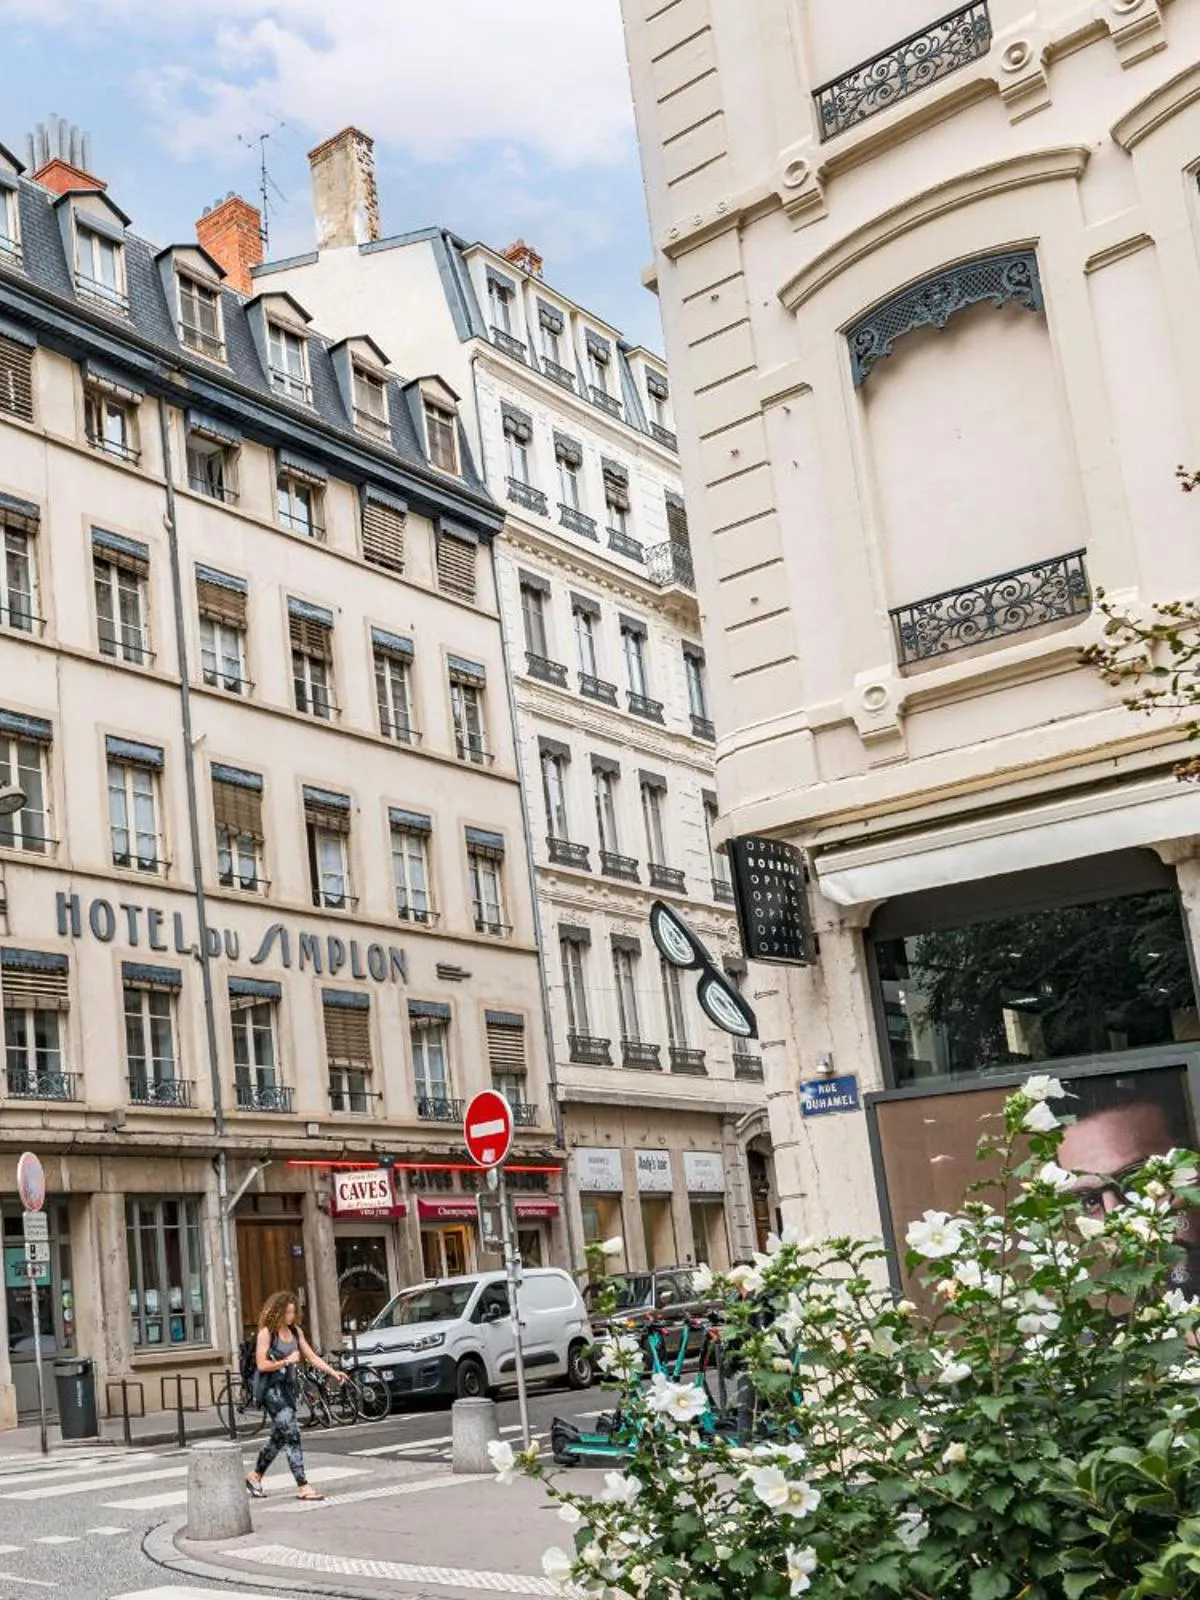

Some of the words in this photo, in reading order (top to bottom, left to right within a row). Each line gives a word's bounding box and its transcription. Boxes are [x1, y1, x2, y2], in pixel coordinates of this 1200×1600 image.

[56, 890, 195, 956] HOTEL
[203, 926, 240, 961] DU
[250, 922, 410, 986] SIMPLON
[818, 1082, 838, 1095] RUE
[805, 1094, 856, 1110] DUHAMEL
[340, 1180, 388, 1201] CAVES
